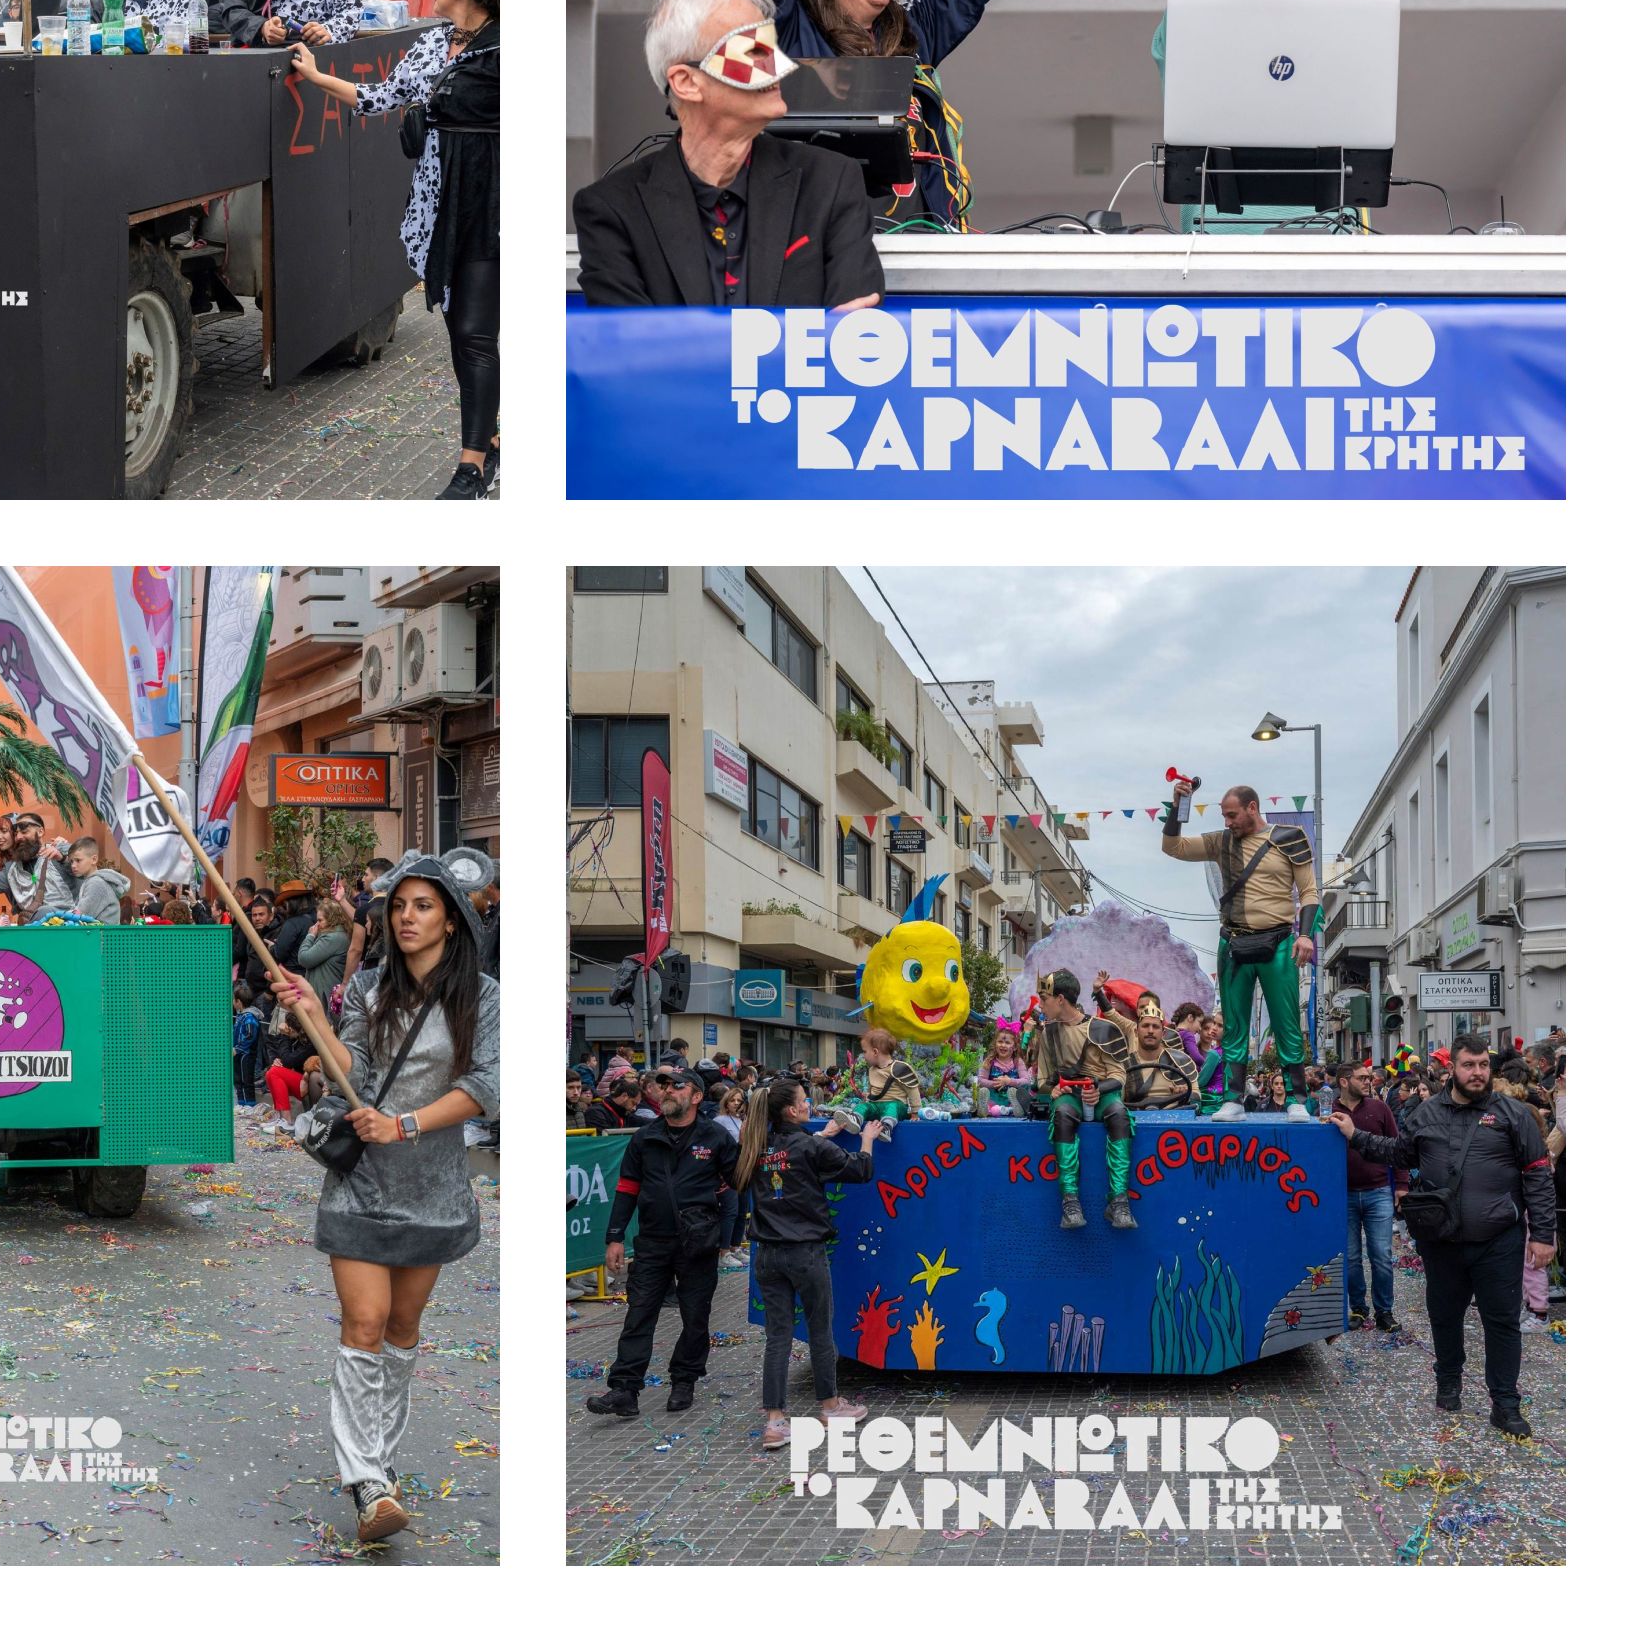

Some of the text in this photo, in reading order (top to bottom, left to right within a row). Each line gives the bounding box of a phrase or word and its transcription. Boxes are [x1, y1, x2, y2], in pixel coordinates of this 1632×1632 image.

[1271, 55, 1292, 81] hp
[299, 765, 379, 782] ΟΠΤΙΚΑ
[325, 783, 370, 794] OPTICS
[1438, 977, 1473, 985] ΟΠΤΙΚΑ
[1425, 987, 1486, 995] ΣΤΑΓΚΟΥΡΑΚΗ
[576, 996, 605, 1006] NBG
[1129, 1129, 1319, 1213] αθαρισες
